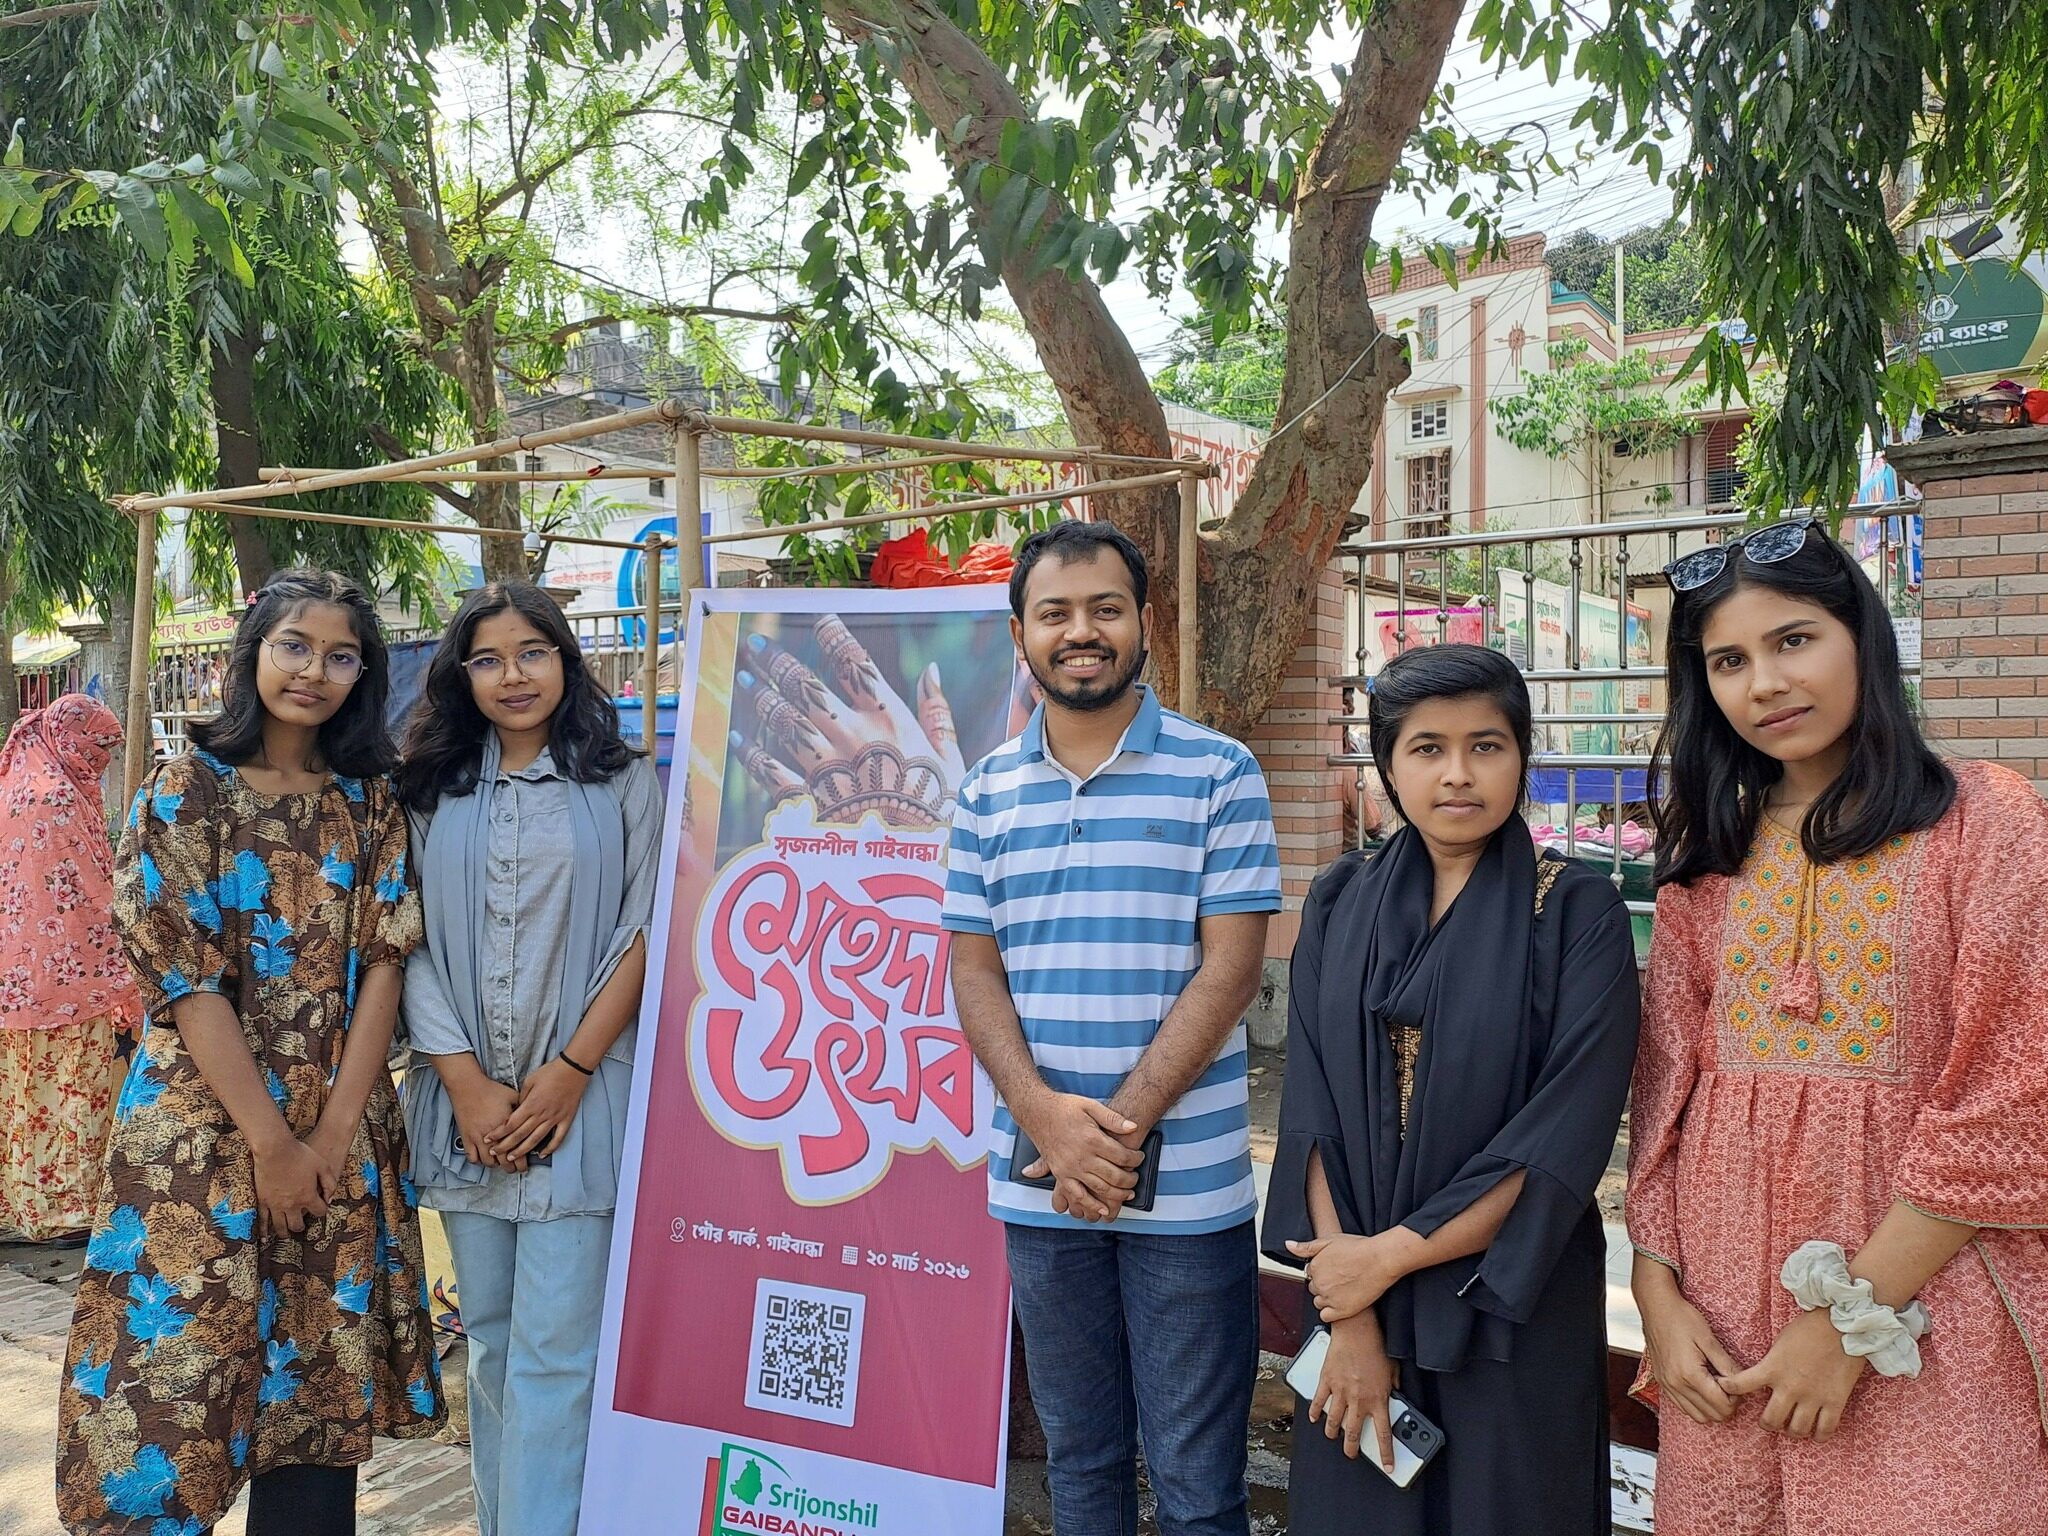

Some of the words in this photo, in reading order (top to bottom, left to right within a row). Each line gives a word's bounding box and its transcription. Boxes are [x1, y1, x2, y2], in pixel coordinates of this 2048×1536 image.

[1949, 320, 2009, 340] ব্যাংক
[192, 616, 236, 636] হাউজ
[774, 832, 858, 860] সৃজনশীল
[864, 835, 939, 862] গাইবান্ধা
[692, 1220, 723, 1243] পৌর
[727, 1227, 761, 1250] পার্ক,
[766, 1232, 825, 1258] গাইবান্ধা
[866, 1250, 887, 1267] ২০
[892, 1251, 919, 1273] মার্চ
[924, 1258, 971, 1280] ২০২৬
[768, 1483, 878, 1527] Srijonshil
